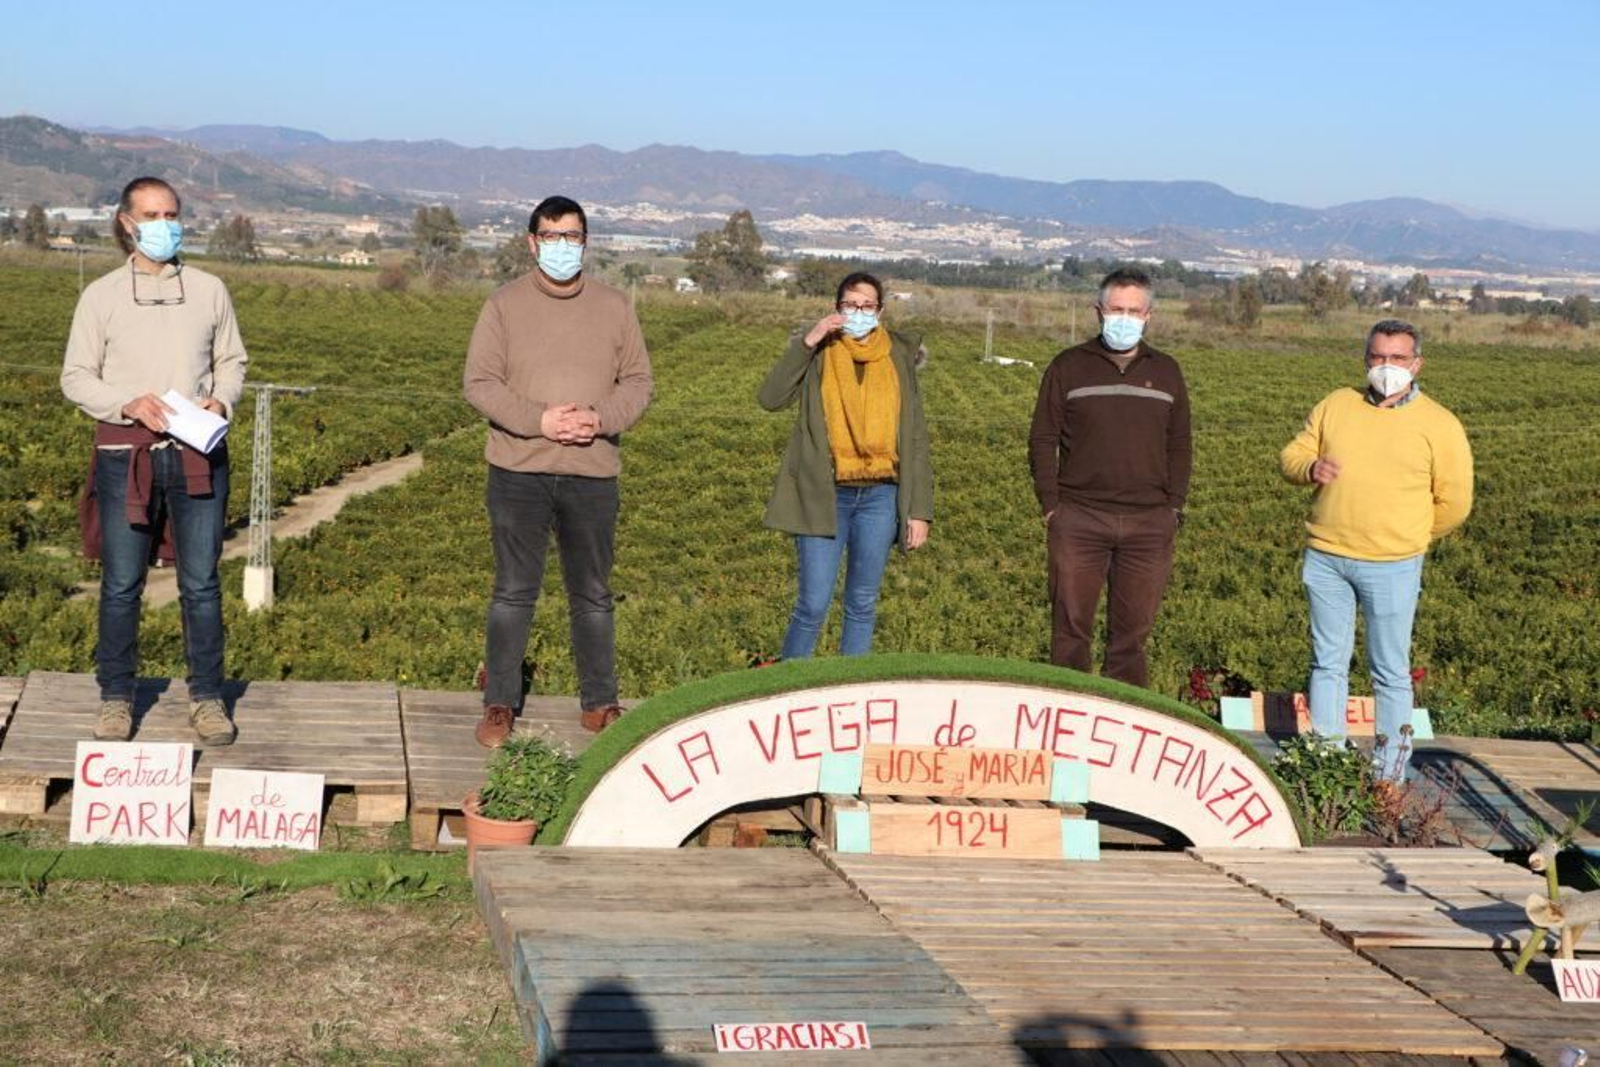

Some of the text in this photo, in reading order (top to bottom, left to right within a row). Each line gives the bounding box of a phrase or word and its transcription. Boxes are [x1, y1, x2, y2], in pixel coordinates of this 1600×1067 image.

[81, 746, 188, 788] Central
[642, 699, 1273, 840] LA VEGA de MESTANZA
[876, 747, 1046, 797] JOSÉ y MARÍA
[250, 774, 286, 807] de
[86, 801, 188, 841] PARK
[216, 807, 320, 848] MALAGA
[927, 809, 1008, 849] 1924
[719, 1022, 866, 1050] ¡GRACIAS!
